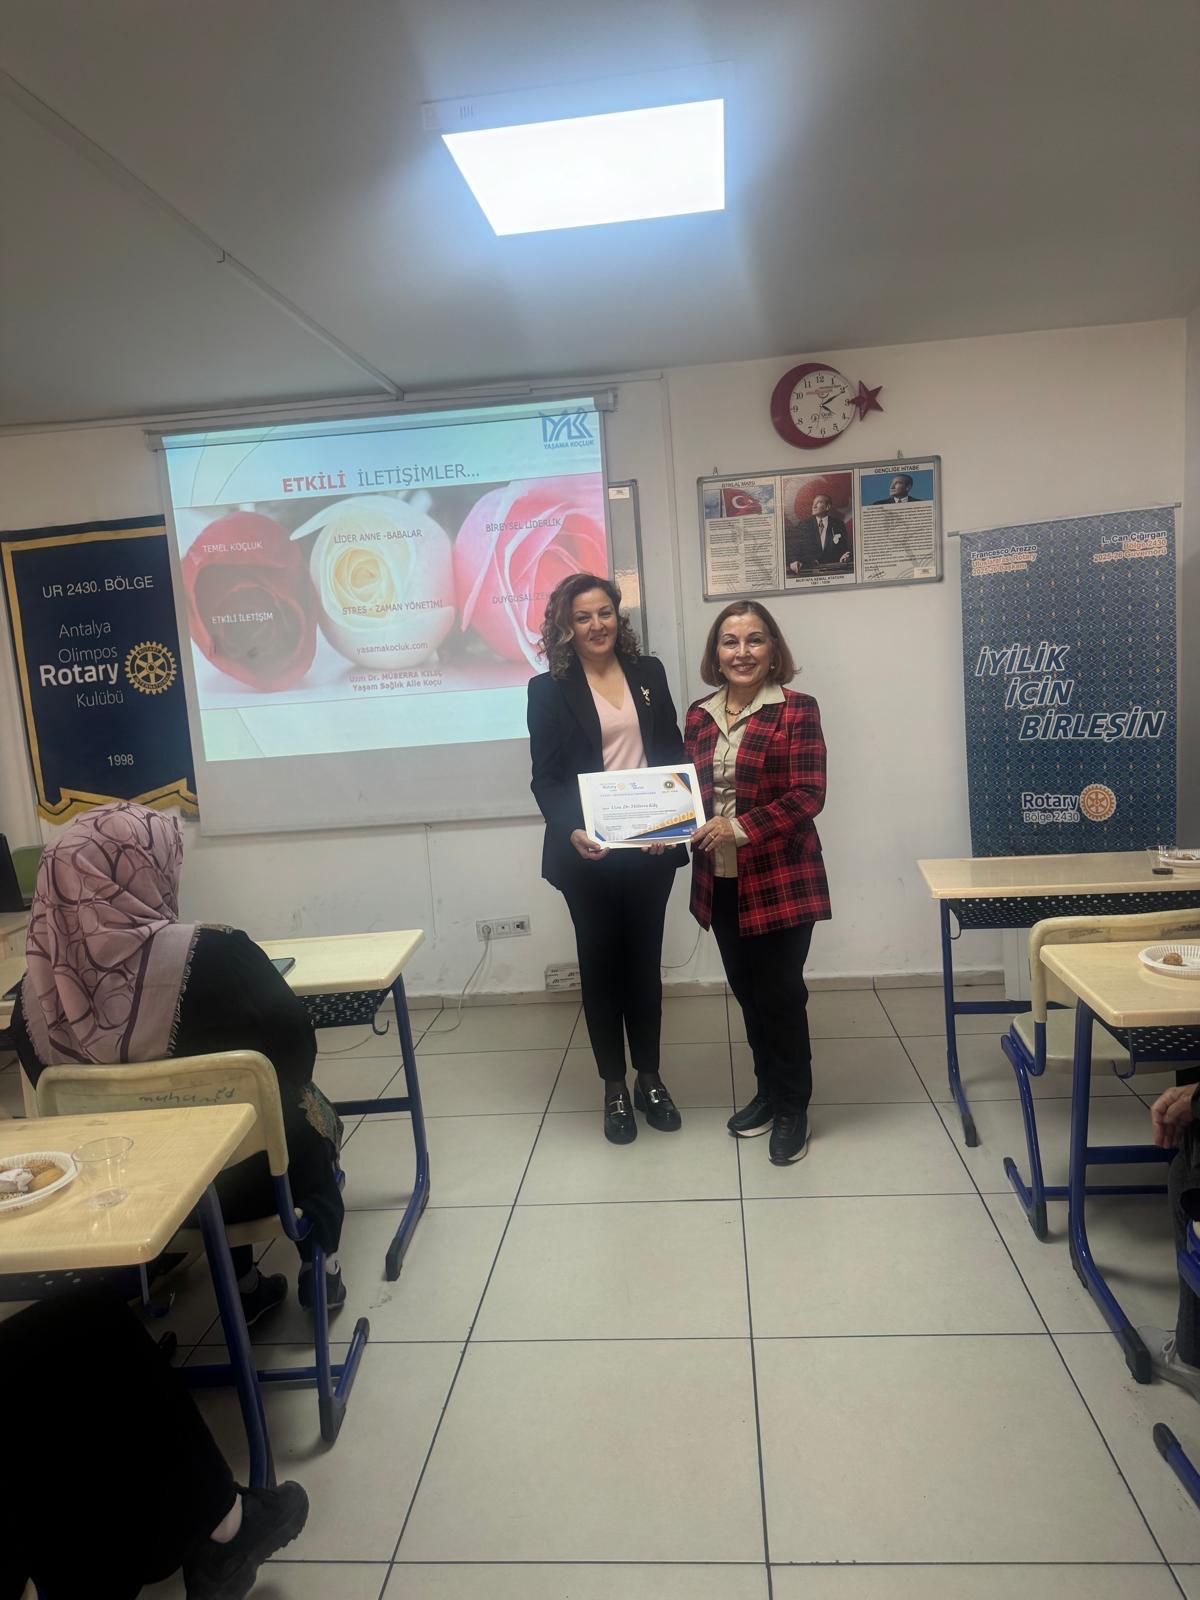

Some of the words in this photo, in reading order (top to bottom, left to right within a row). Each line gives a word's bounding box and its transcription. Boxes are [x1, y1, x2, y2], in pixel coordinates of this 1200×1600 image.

[282, 470, 346, 493] ETKİLİ
[357, 464, 480, 487] İLETİŞİMLER...
[485, 520, 523, 533] BİREYSEL
[201, 543, 228, 552] TEMEL
[230, 540, 263, 552] KOÇLUK
[334, 532, 357, 544] LİDER
[360, 531, 381, 541] ANNE
[971, 548, 1009, 559] Francesco
[1010, 544, 1037, 554] Arezzo
[42, 584, 63, 599] UR
[66, 580, 101, 596] 2430.
[104, 575, 154, 591] BÖLGE
[375, 603, 403, 613] ZAMAN
[58, 619, 112, 638] Antalya
[58, 646, 118, 663] Olimpos
[356, 642, 428, 655] yasamakocluk.com
[975, 641, 1071, 676] İYİLİK
[39, 662, 119, 687] Rotary
[353, 682, 378, 692] Yaşam
[1005, 674, 1075, 710] İÇİN
[76, 690, 124, 708] Kulübü
[1019, 705, 1167, 743] BİRLEŞİN
[107, 754, 134, 766] 1998
[1021, 791, 1080, 811] Rotary
[1023, 811, 1054, 825] Bölge
[1053, 810, 1080, 823] 2430
